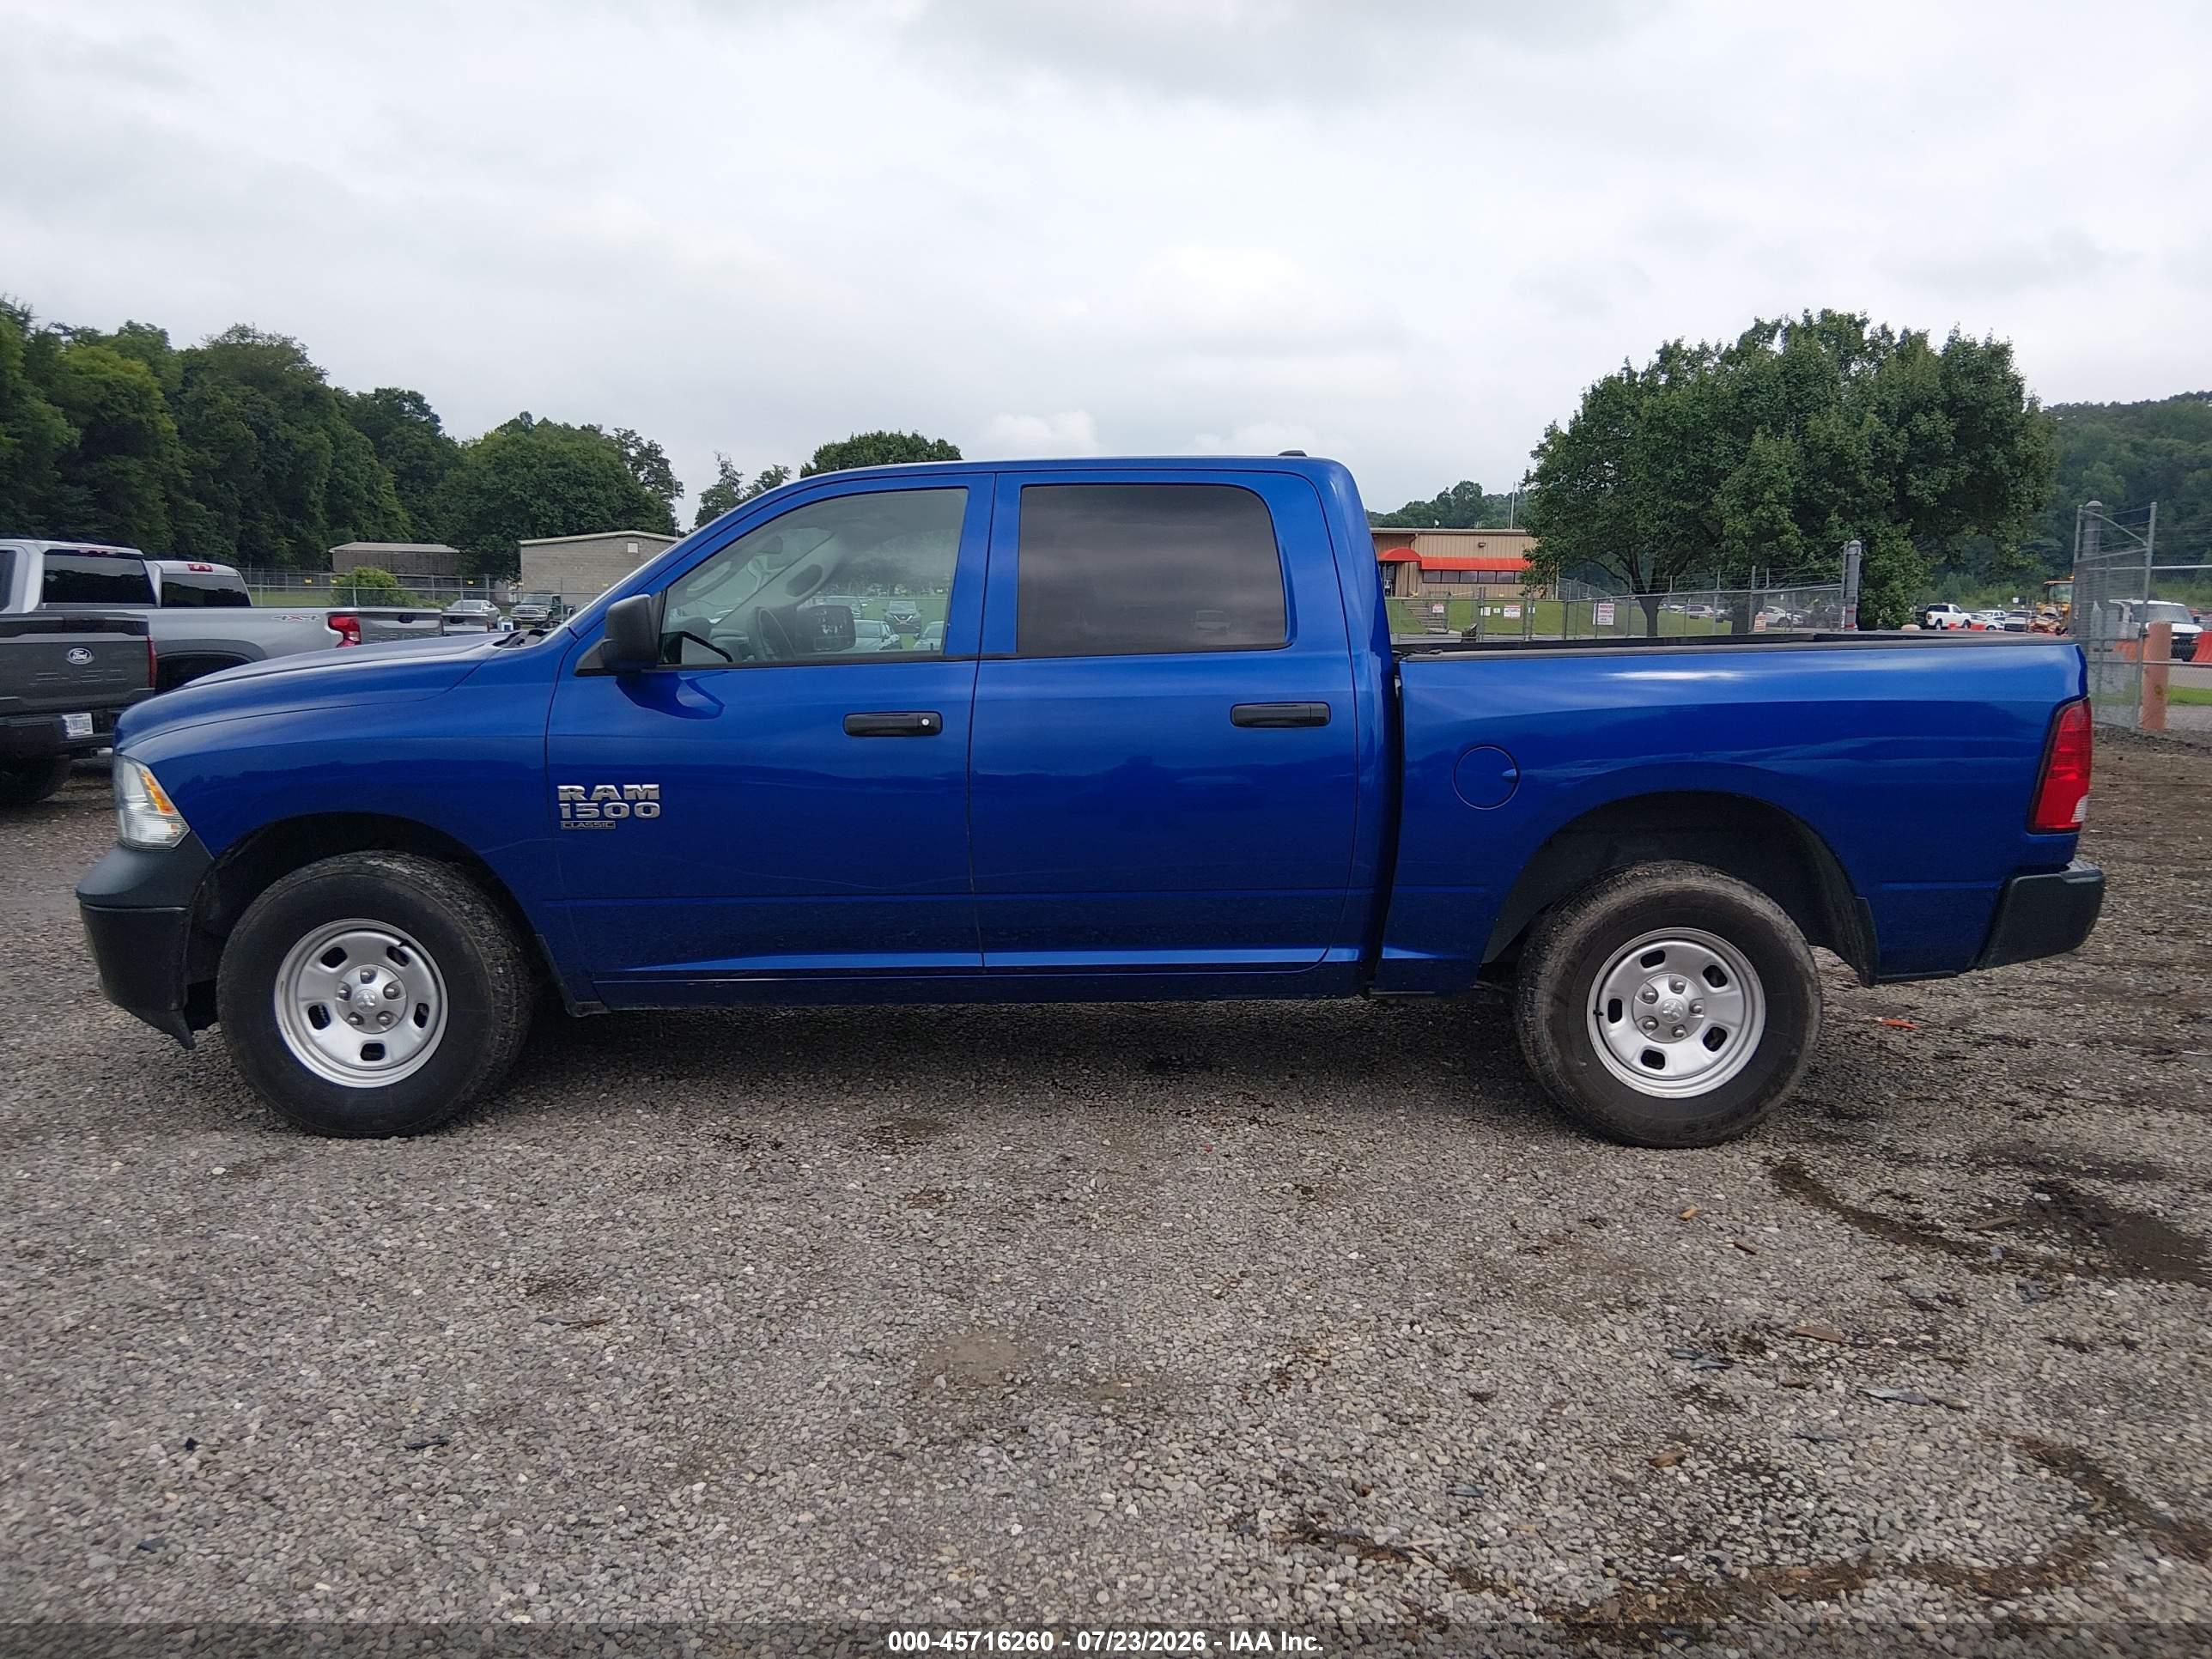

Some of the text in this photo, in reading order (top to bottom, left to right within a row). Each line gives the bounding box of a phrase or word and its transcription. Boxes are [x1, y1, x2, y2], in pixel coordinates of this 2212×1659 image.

[557, 784, 659, 800] RAM
[559, 802, 660, 818] 1500
[562, 821, 616, 830] CLASSIC
